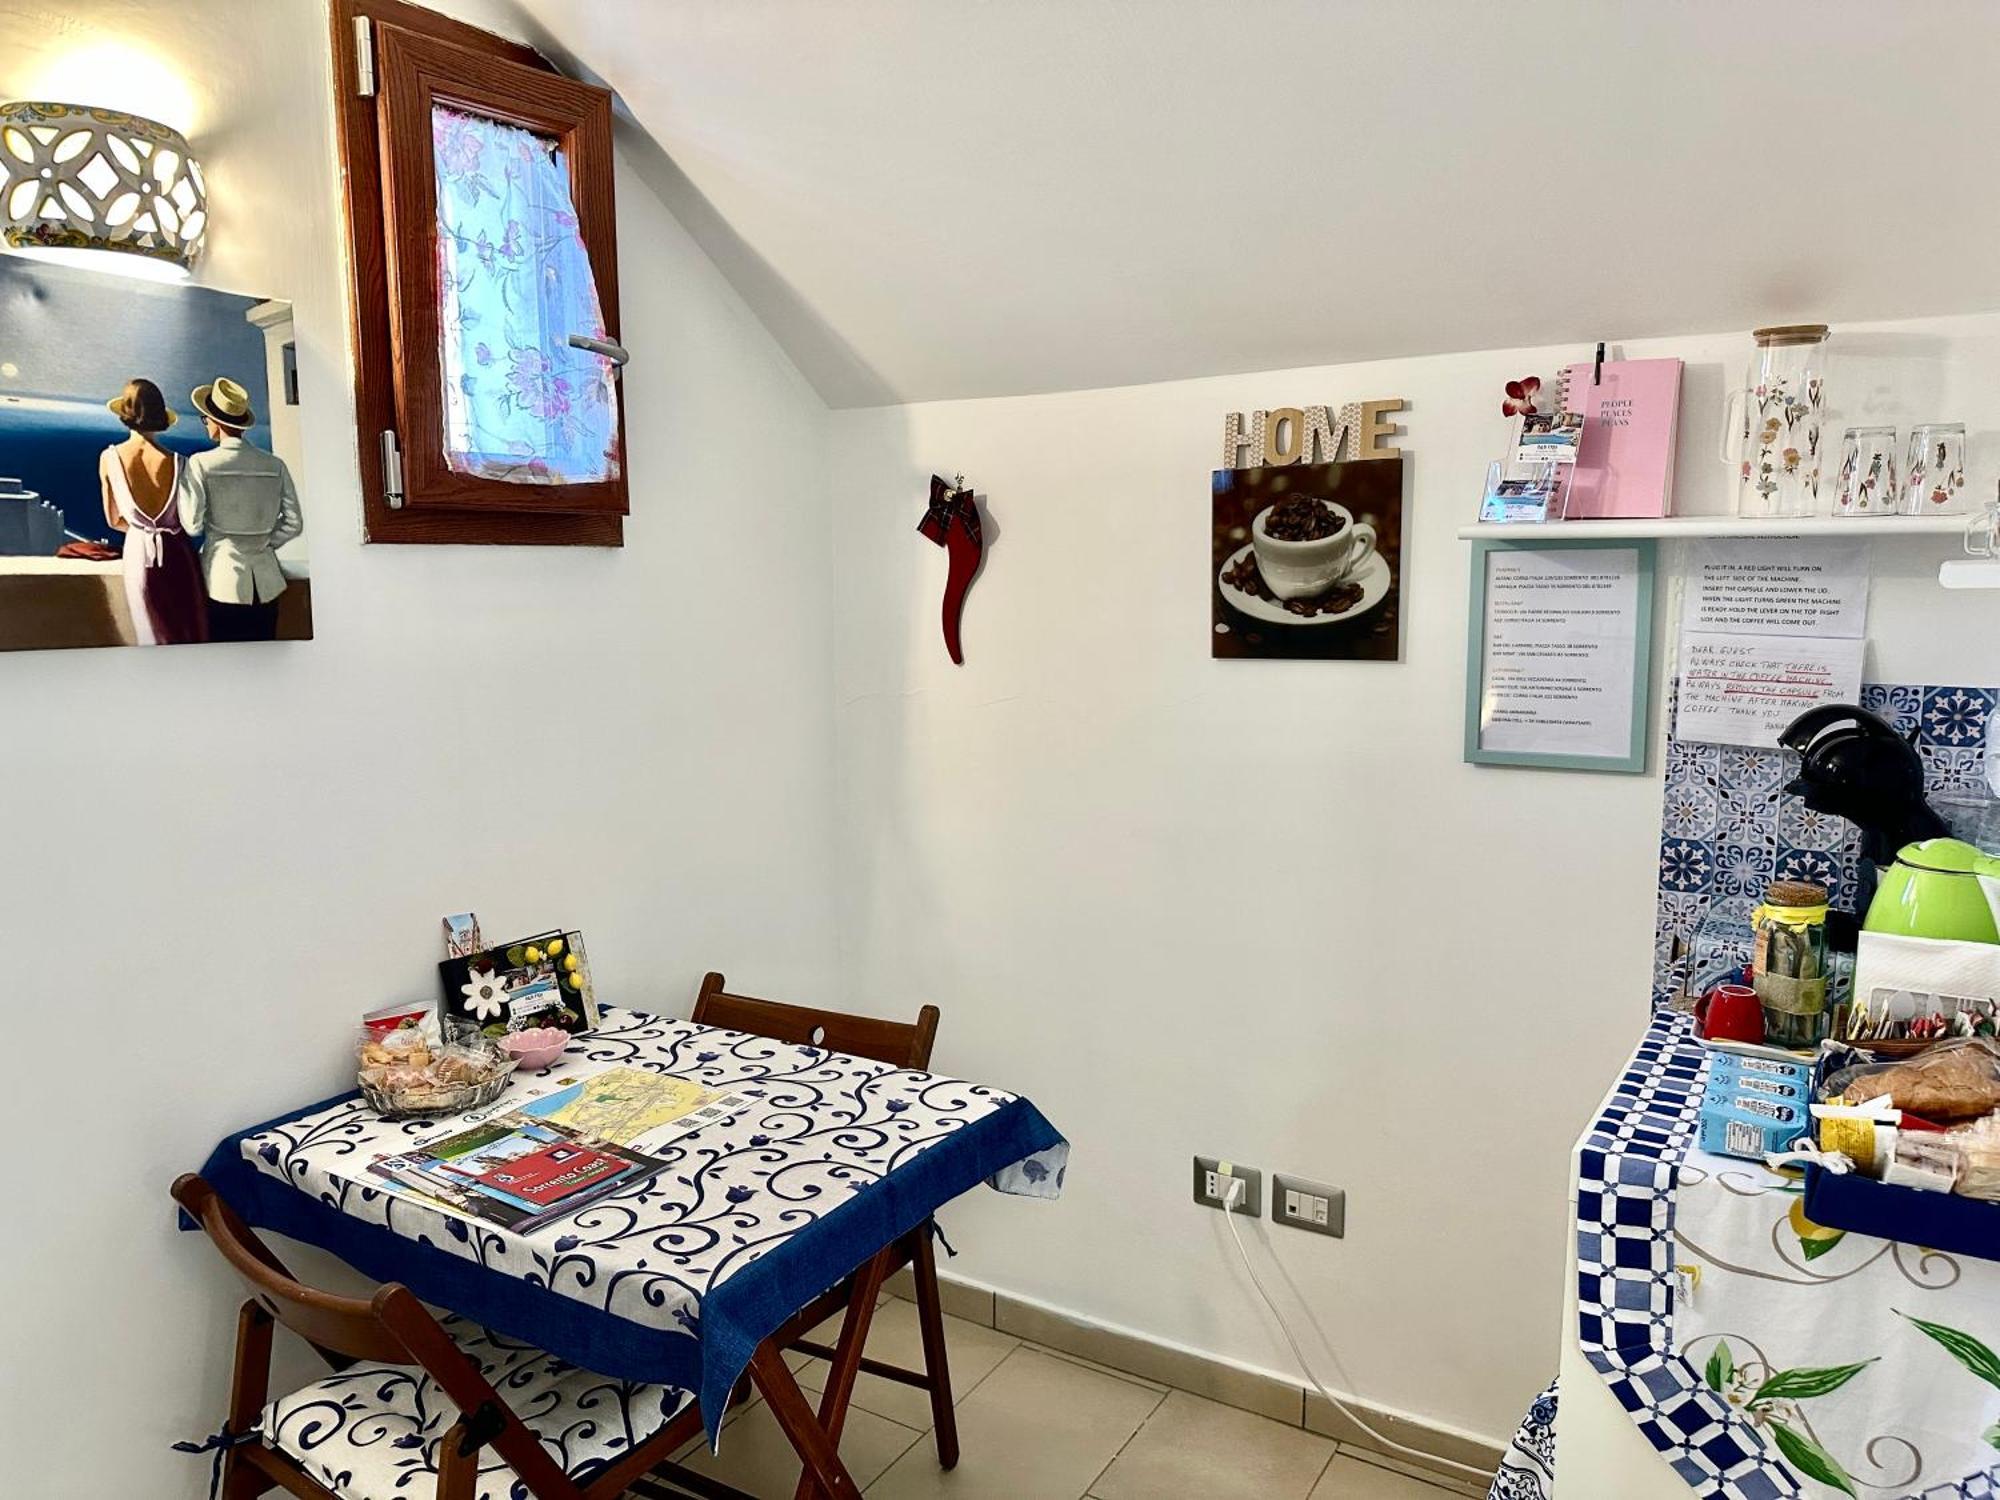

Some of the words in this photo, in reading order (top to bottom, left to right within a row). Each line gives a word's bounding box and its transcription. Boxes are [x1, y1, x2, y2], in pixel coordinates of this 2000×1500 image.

[1600, 400, 1632, 409] PEOPLE
[1600, 409, 1632, 418] PLACES
[1600, 419, 1629, 428] PLANS
[1224, 399, 1403, 470] HOME
[1765, 586, 1779, 594] AND
[1760, 607, 1779, 615] LEVER
[1690, 657, 1726, 668] ALWAYS
[1729, 659, 1757, 669] CHECK
[1760, 660, 1783, 670] THAT
[1686, 680, 1721, 690] ALWAYS
[1685, 693, 1700, 702] THE
[1705, 694, 1743, 705] MACHINE
[1747, 696, 1777, 707] AFTER
[1729, 707, 1757, 717] THANK
[1762, 708, 1780, 718] YOU
[522, 1172, 577, 1194] Sorrento
[573, 1157, 609, 1174] Coast
